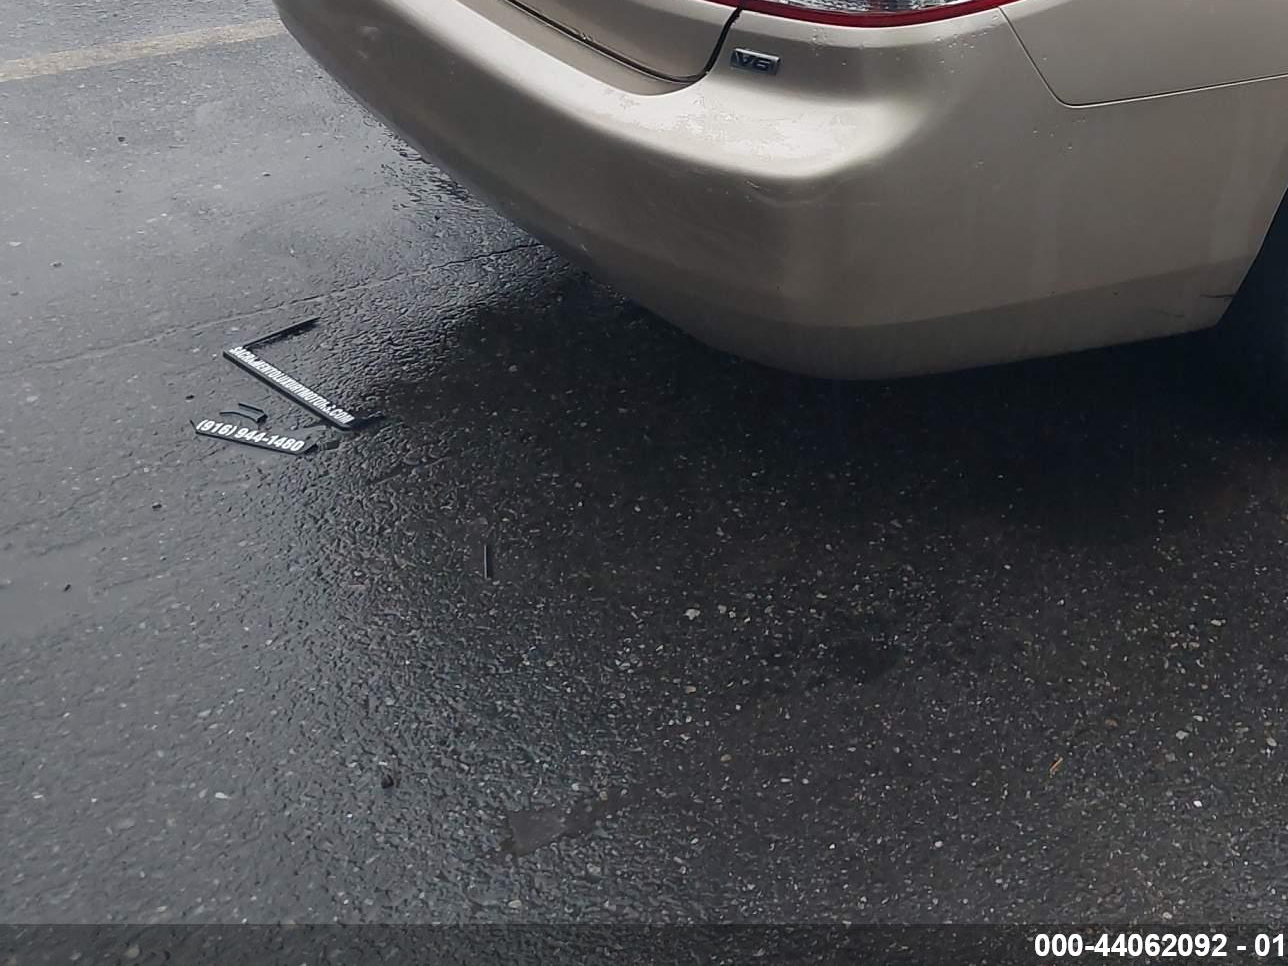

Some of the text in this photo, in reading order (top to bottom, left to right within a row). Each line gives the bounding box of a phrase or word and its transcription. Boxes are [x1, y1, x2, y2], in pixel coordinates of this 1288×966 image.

[734, 51, 772, 70] V6
[196, 419, 305, 452] (916) 944-1480
